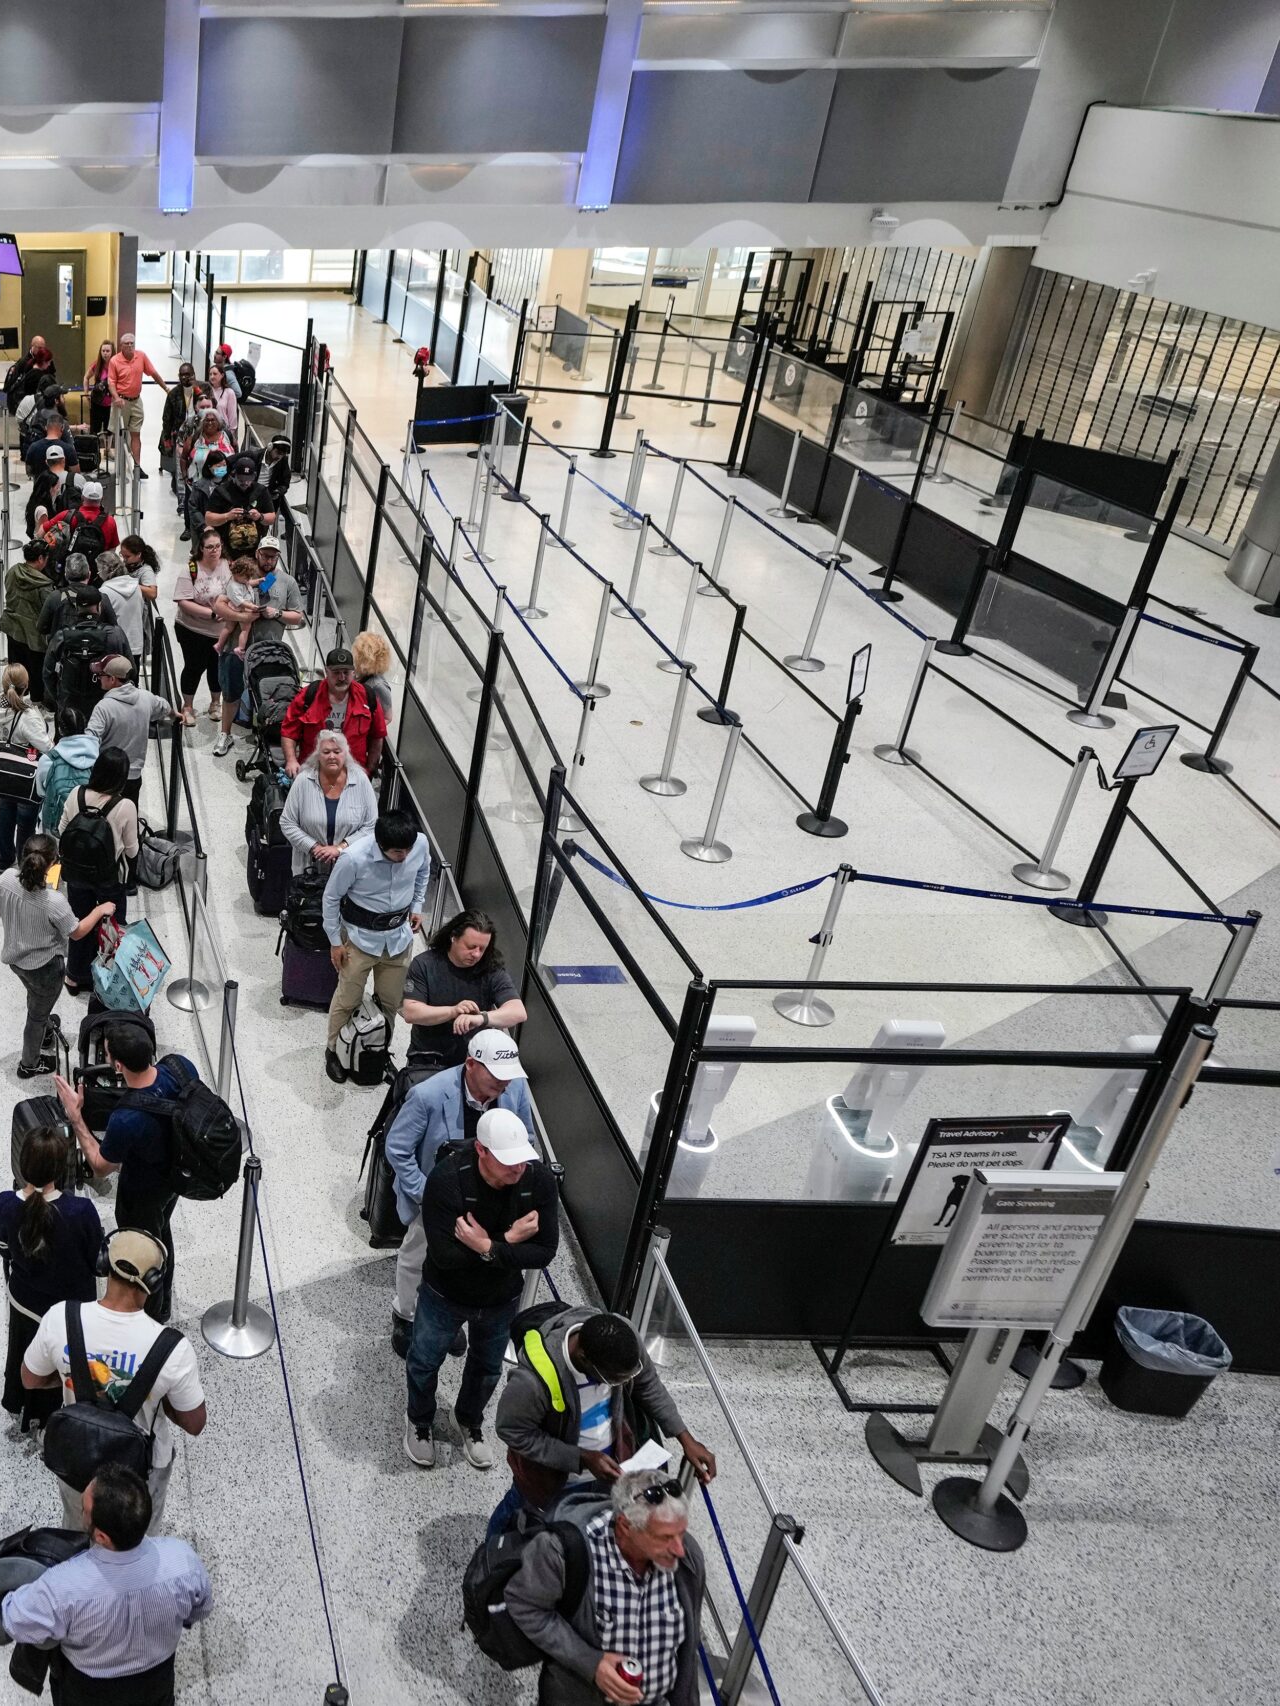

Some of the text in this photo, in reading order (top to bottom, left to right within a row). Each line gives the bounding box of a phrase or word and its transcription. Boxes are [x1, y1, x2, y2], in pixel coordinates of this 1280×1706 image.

[939, 1130, 998, 1138] Travel Advisory
[957, 1160, 968, 1168] do
[986, 1160, 1001, 1168] pet
[1002, 1160, 1024, 1168] dogs.
[996, 1200, 1056, 1208] Gate Screening
[986, 1223, 1000, 1231] All
[1001, 1224, 1040, 1232] persons
[1042, 1223, 1061, 1231] and
[982, 1232, 997, 1240] are
[999, 1232, 1034, 1241] subject
[1037, 1232, 1048, 1240] to
[978, 1240, 1064, 1250] screening prior to
[974, 1249, 1018, 1258] boarding
[1020, 1249, 1038, 1257] this
[970, 1258, 1080, 1267] Passengers who refuse
[966, 1266, 1065, 1276] screening will not be
[962, 1274, 1010, 1284] permitted
[1012, 1275, 1022, 1283] to
